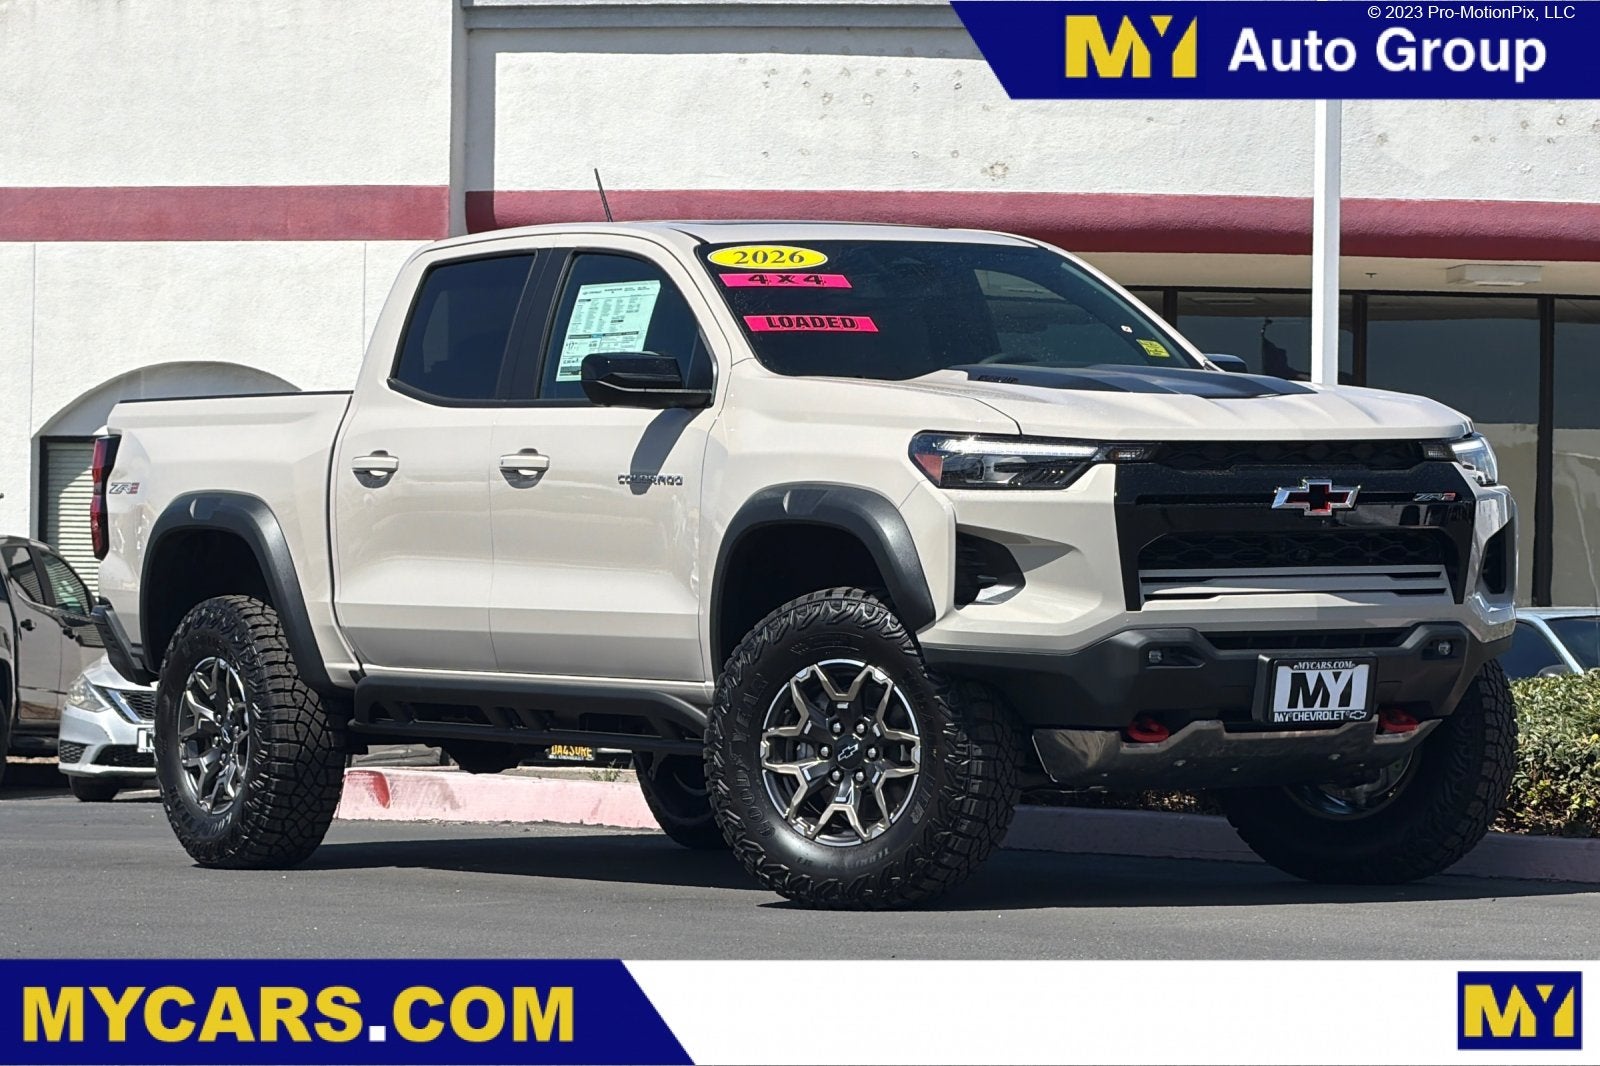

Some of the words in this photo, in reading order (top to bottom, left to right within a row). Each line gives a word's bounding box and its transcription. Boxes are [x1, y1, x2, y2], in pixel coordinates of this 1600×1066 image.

[733, 249, 805, 265] 2026
[765, 316, 860, 330] LOADED
[617, 474, 684, 486] COLORADO
[1287, 671, 1354, 709] MY
[1274, 712, 1290, 723] MY
[1292, 710, 1346, 721] CHEVROLET
